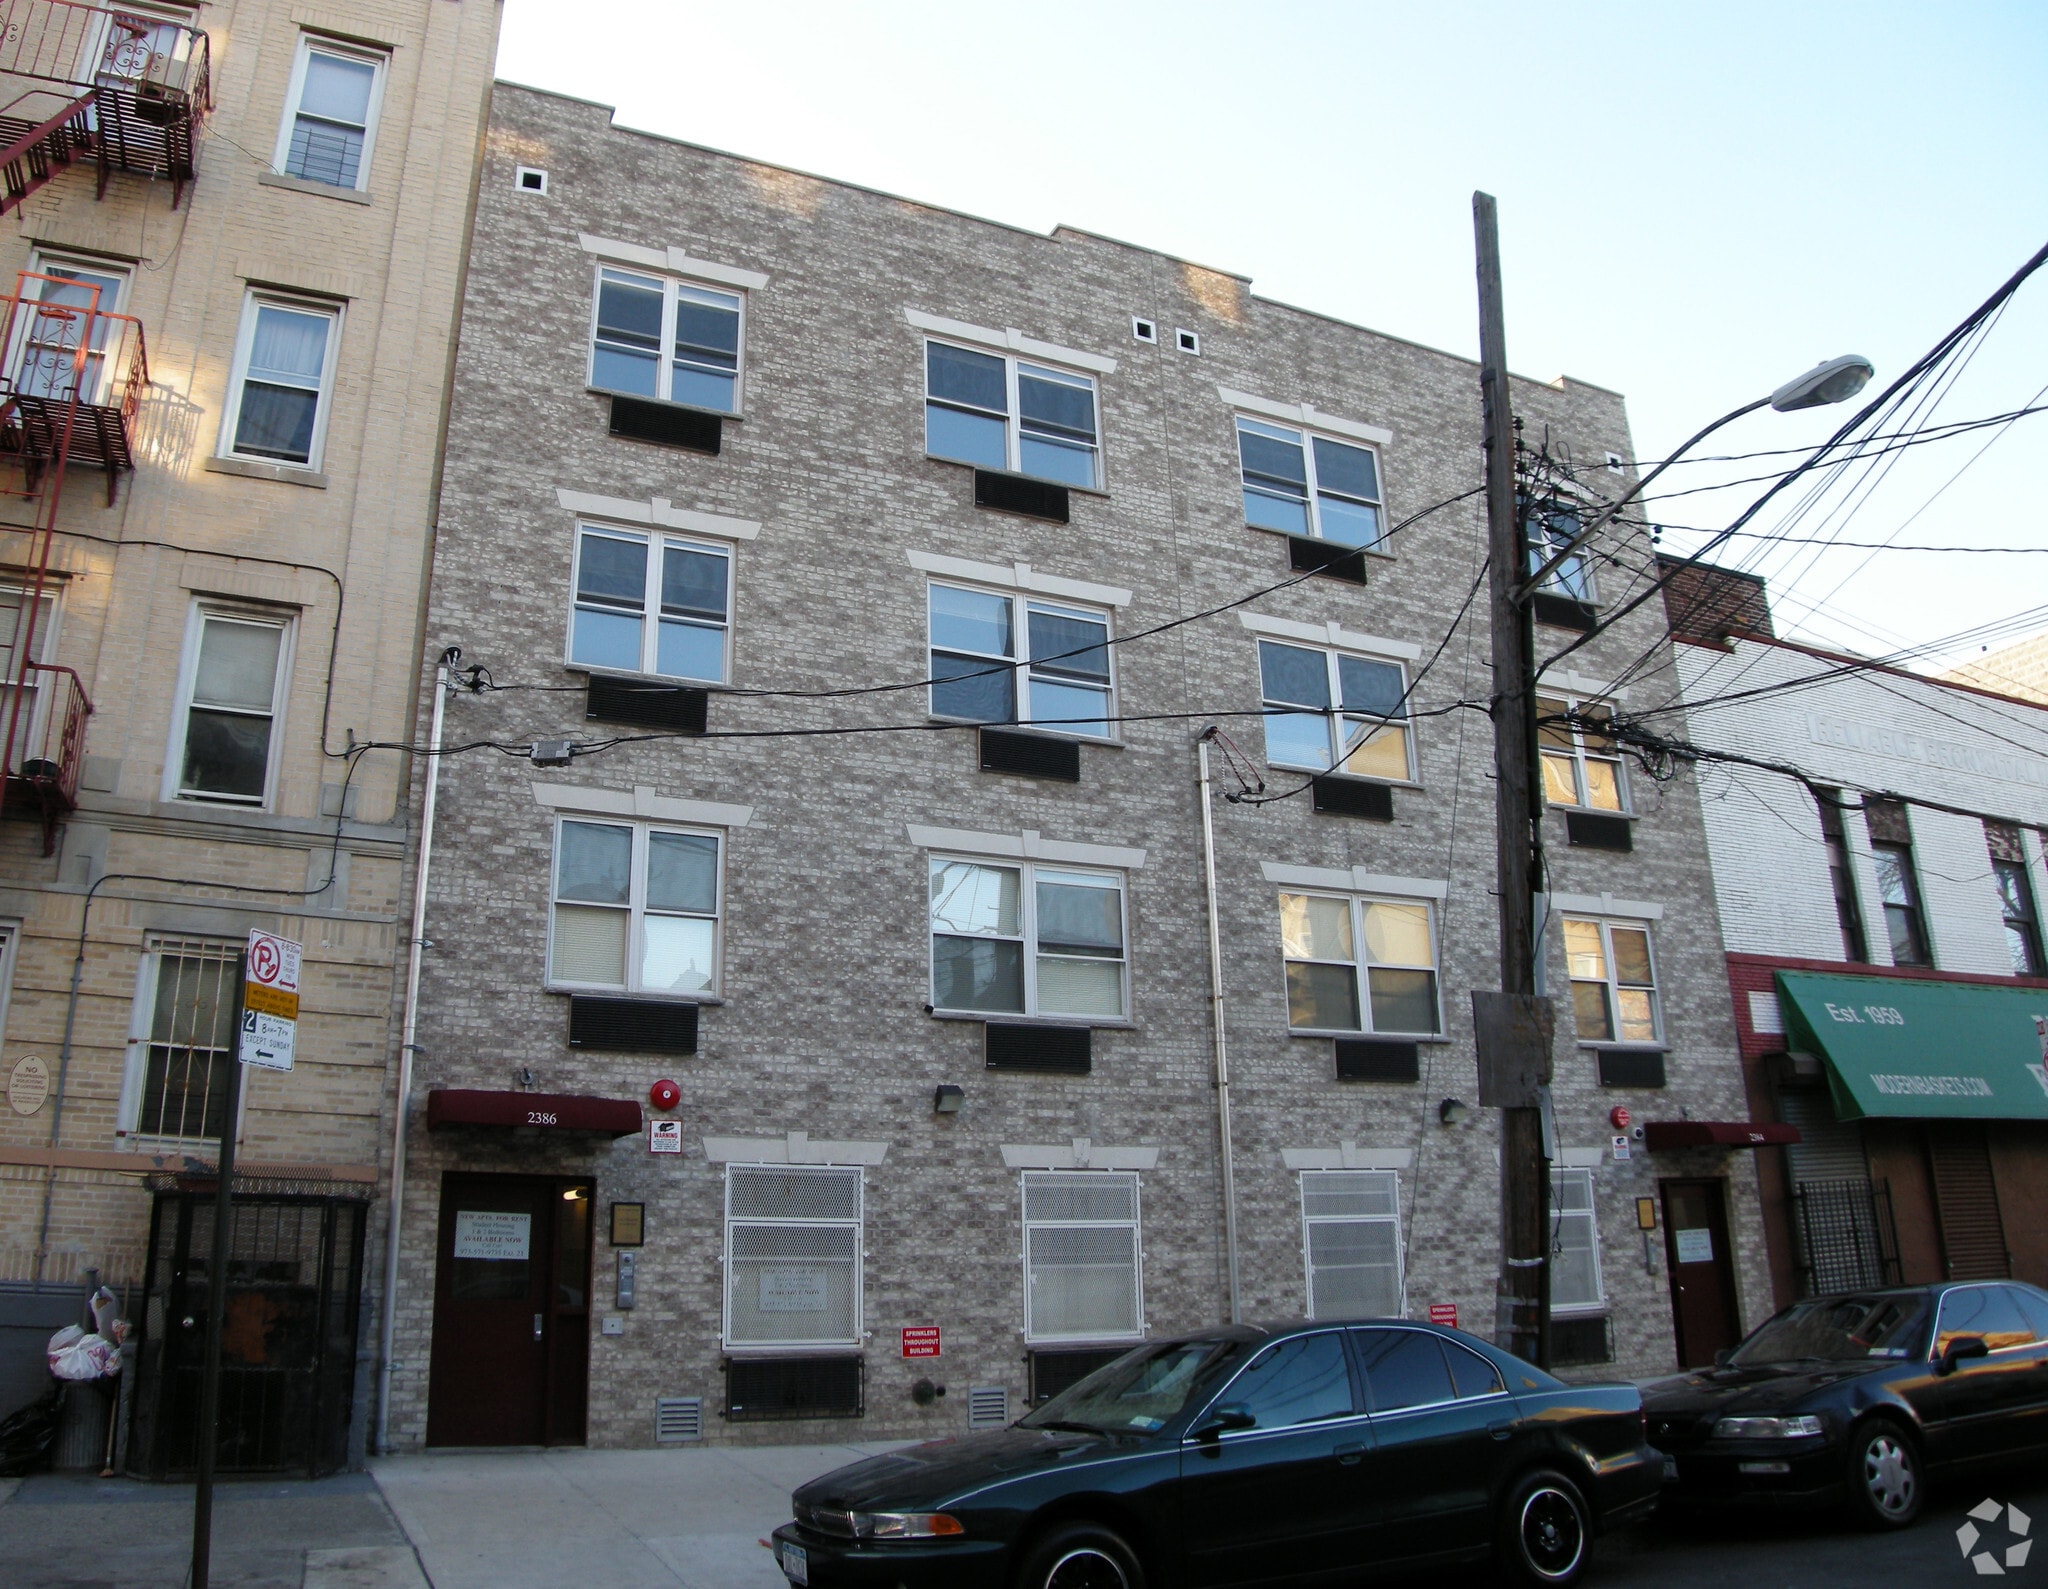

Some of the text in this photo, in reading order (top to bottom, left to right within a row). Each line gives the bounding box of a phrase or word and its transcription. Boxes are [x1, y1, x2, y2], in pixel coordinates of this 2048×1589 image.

[1824, 1002, 1904, 1025] Est. 1959
[245, 1010, 255, 1031] 2
[273, 1017, 292, 1027] PARKING
[245, 1034, 290, 1051] EXCEPT SUNDAY
[25, 1066, 38, 1074] NO
[1869, 1073, 1994, 1096] MODERNBASKETS.COM
[527, 1111, 557, 1125] 2386
[464, 1235, 522, 1244] AVAILABLE NOW
[904, 1338, 939, 1346] THROUGHOUT
[909, 1347, 934, 1355] BUILDING
